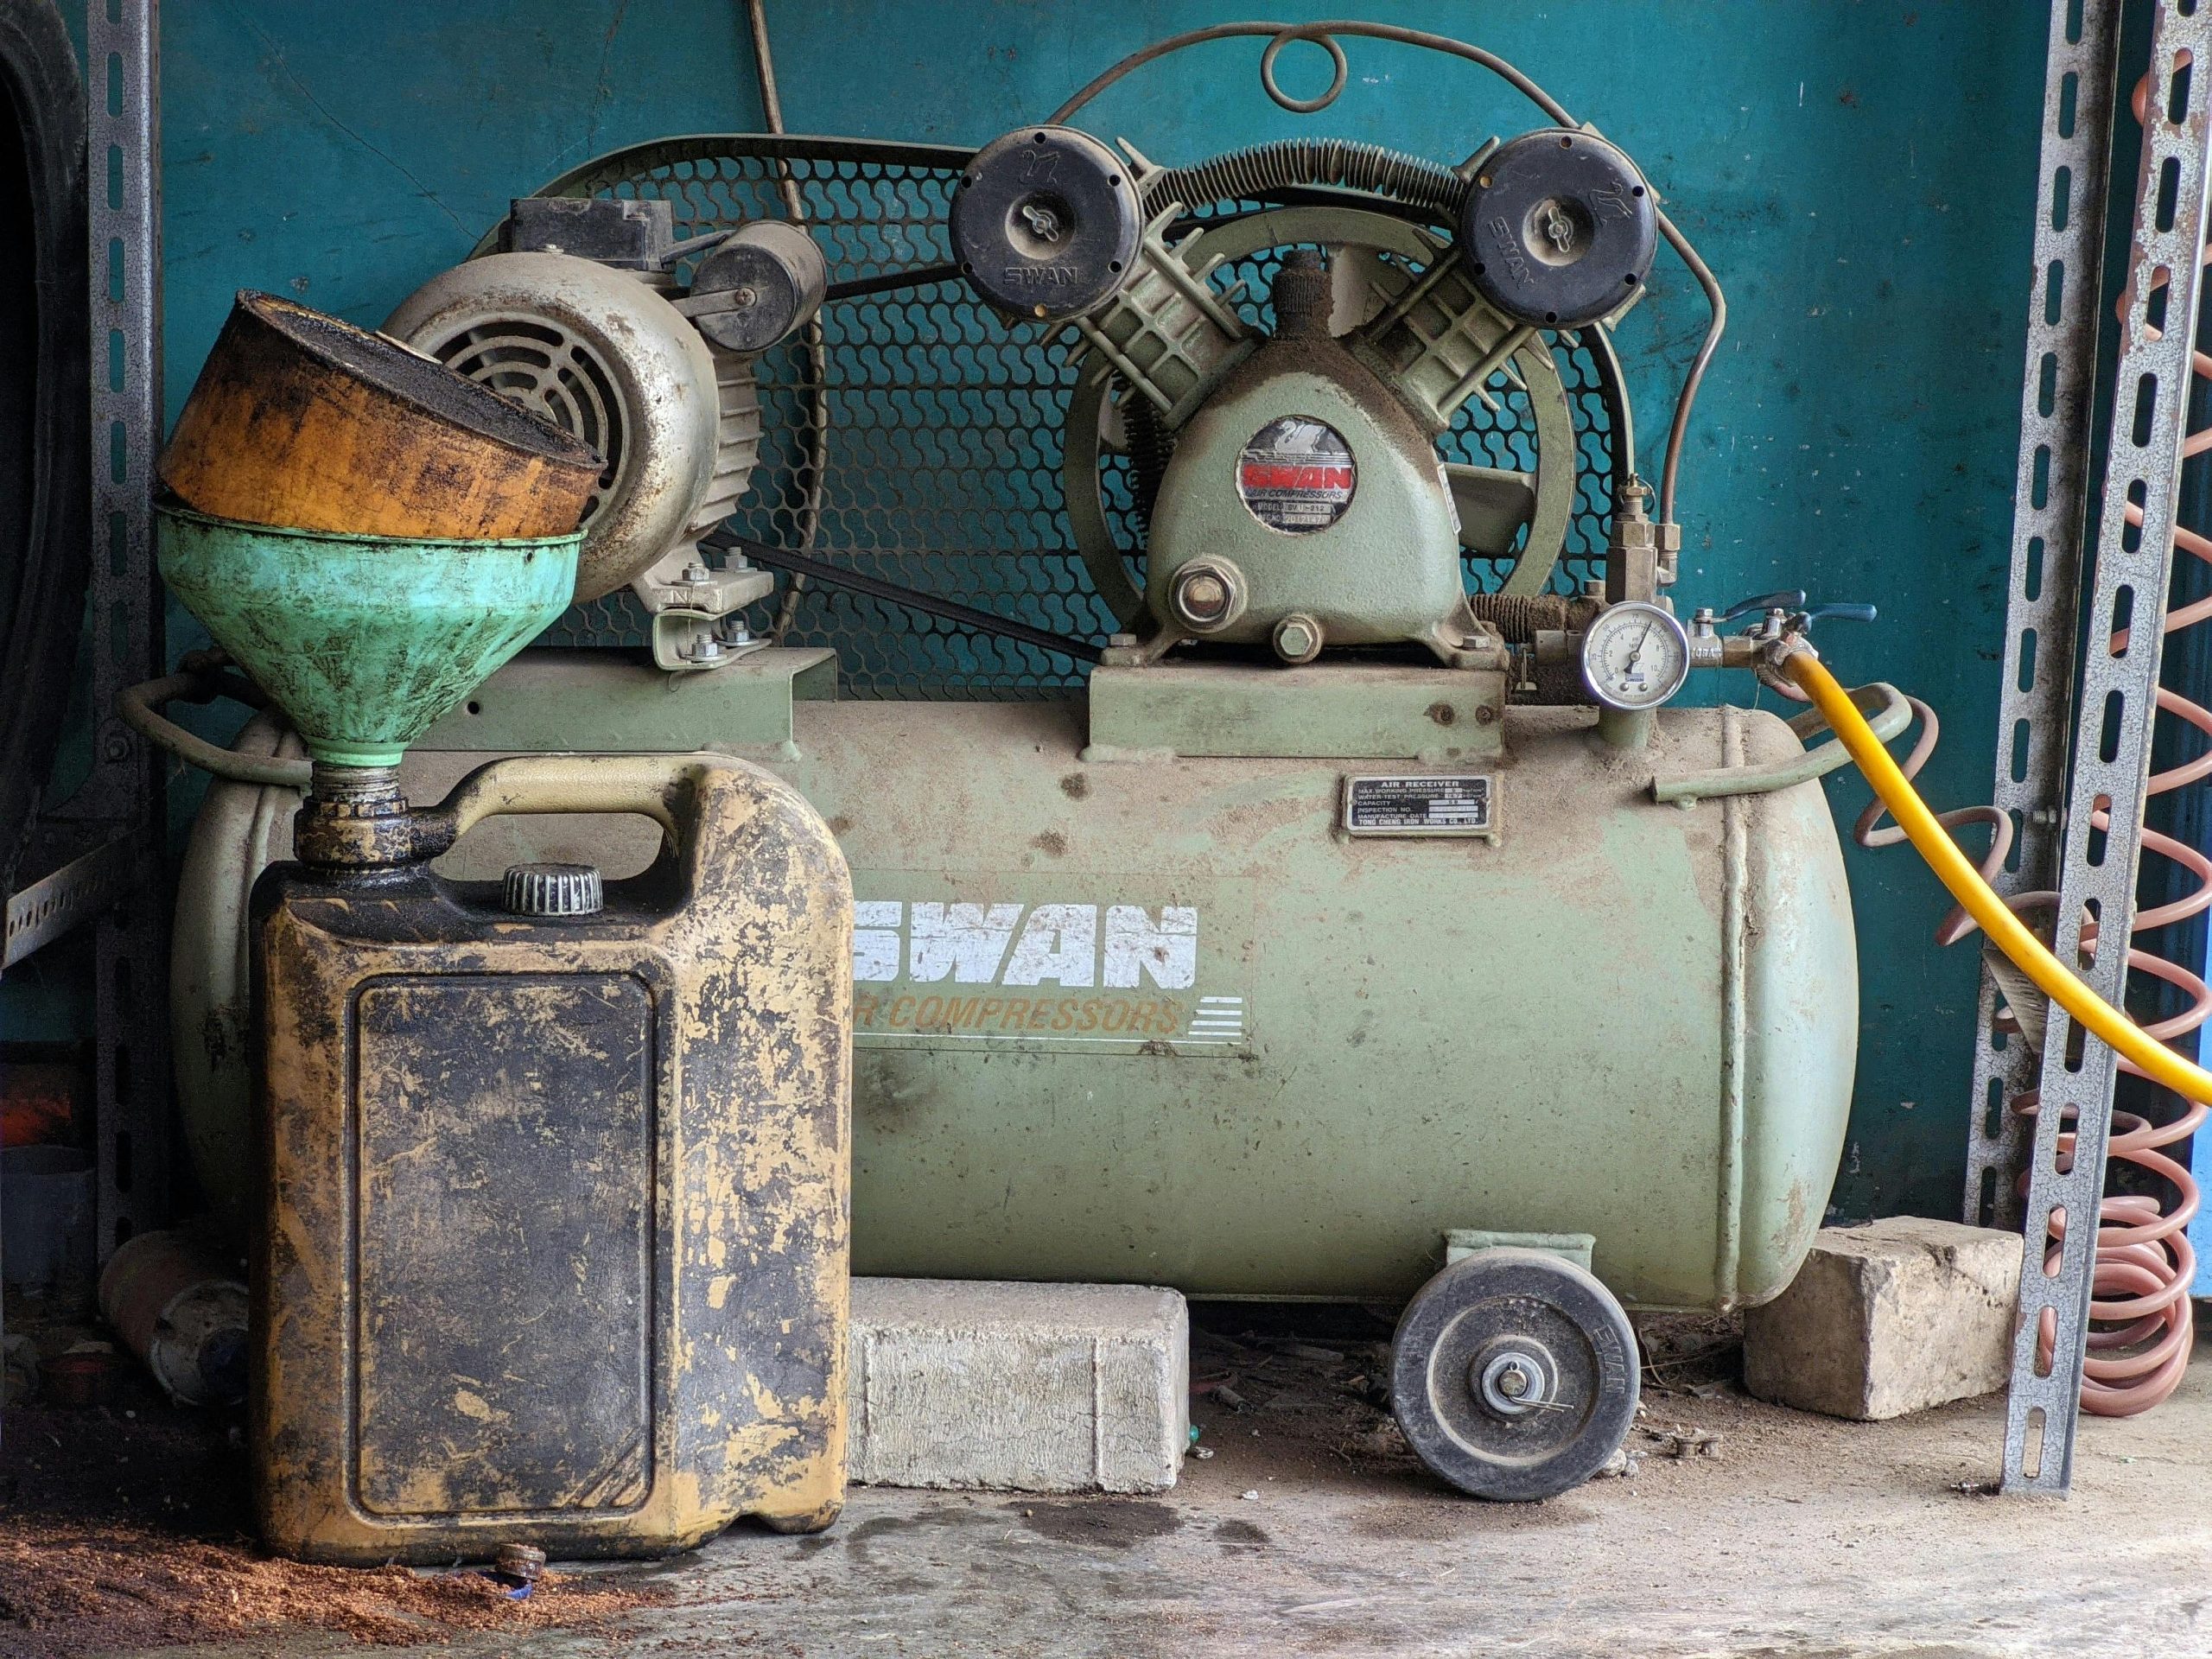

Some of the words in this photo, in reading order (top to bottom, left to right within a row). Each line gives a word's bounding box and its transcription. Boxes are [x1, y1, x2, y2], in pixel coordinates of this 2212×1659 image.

[1004, 266, 1078, 286] SWAN
[1244, 466, 1351, 489] SWAN
[1268, 489, 1343, 499] COMPRESSORS
[1650, 664, 1658, 672] 10
[854, 901, 1198, 989] SWAN
[888, 995, 1182, 1034] COMPRESSORS
